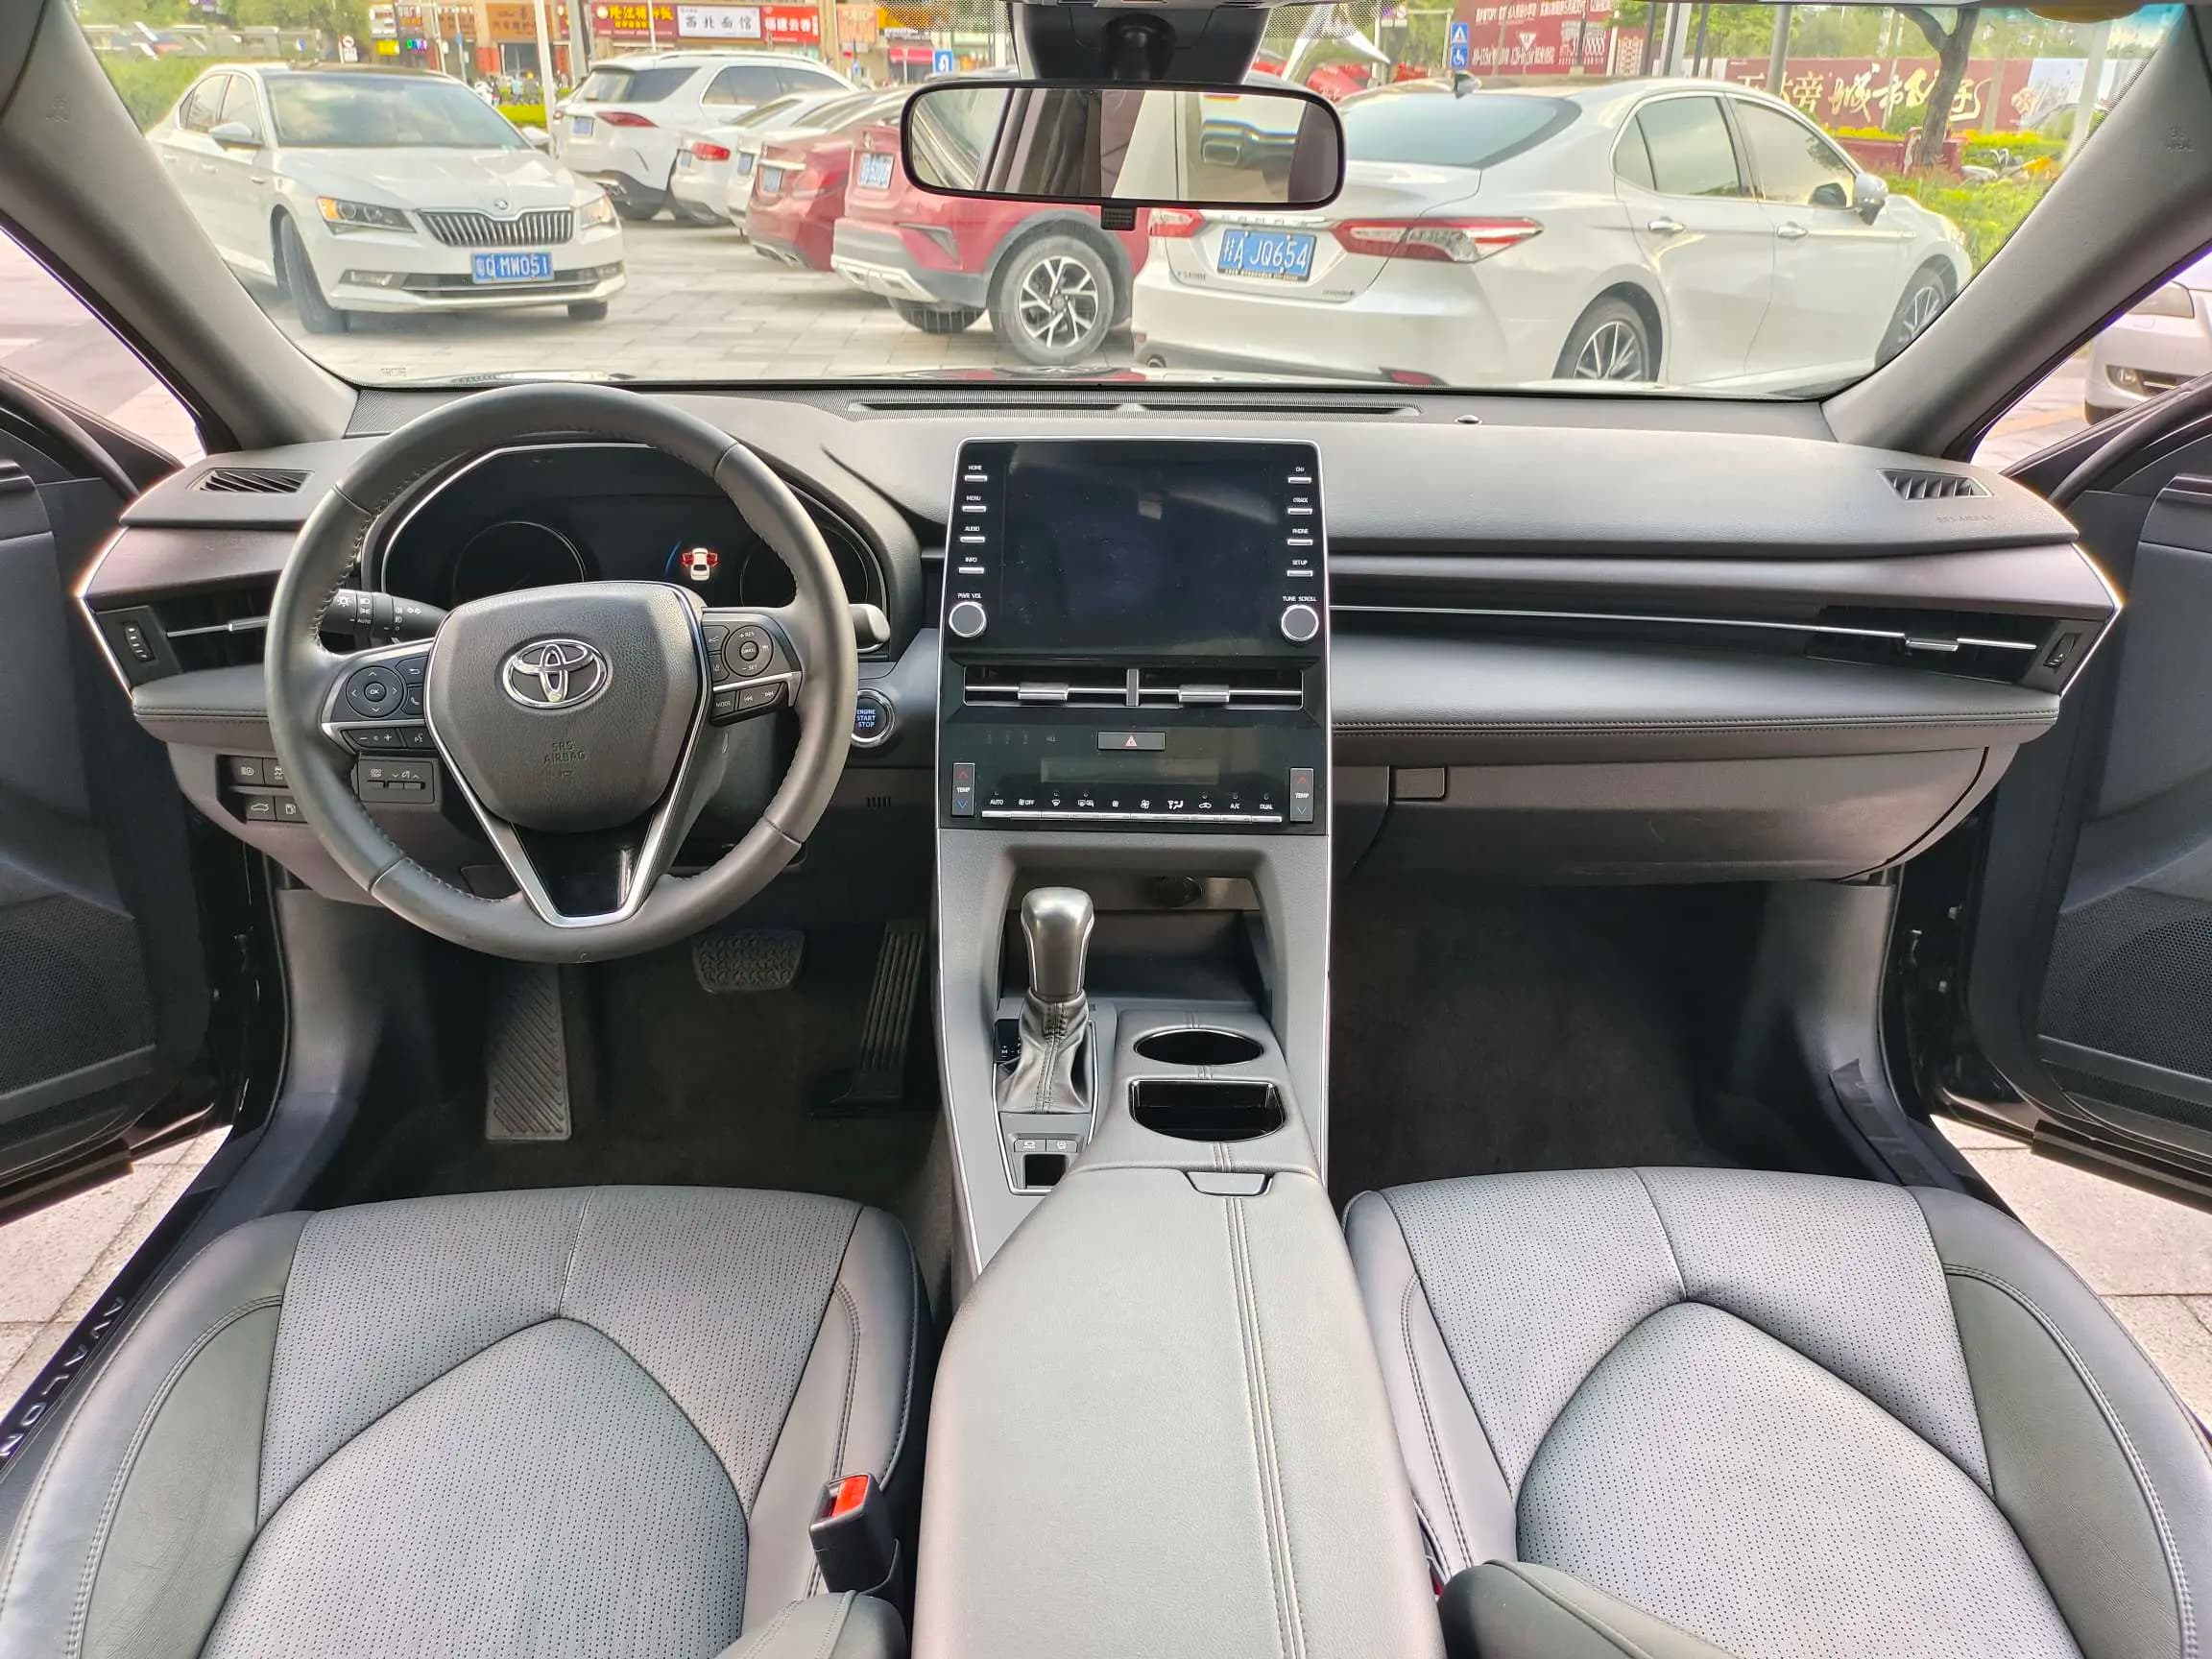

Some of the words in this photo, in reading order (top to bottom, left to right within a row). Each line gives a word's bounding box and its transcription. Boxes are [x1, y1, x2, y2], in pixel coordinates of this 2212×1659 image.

[685, 14, 753, 30] 西北面馆
[715, 700, 731, 709] MODE
[552, 740, 575, 753] SRS
[543, 749, 587, 766] AIRBAG
[0, 1296, 125, 1456] AVALON
